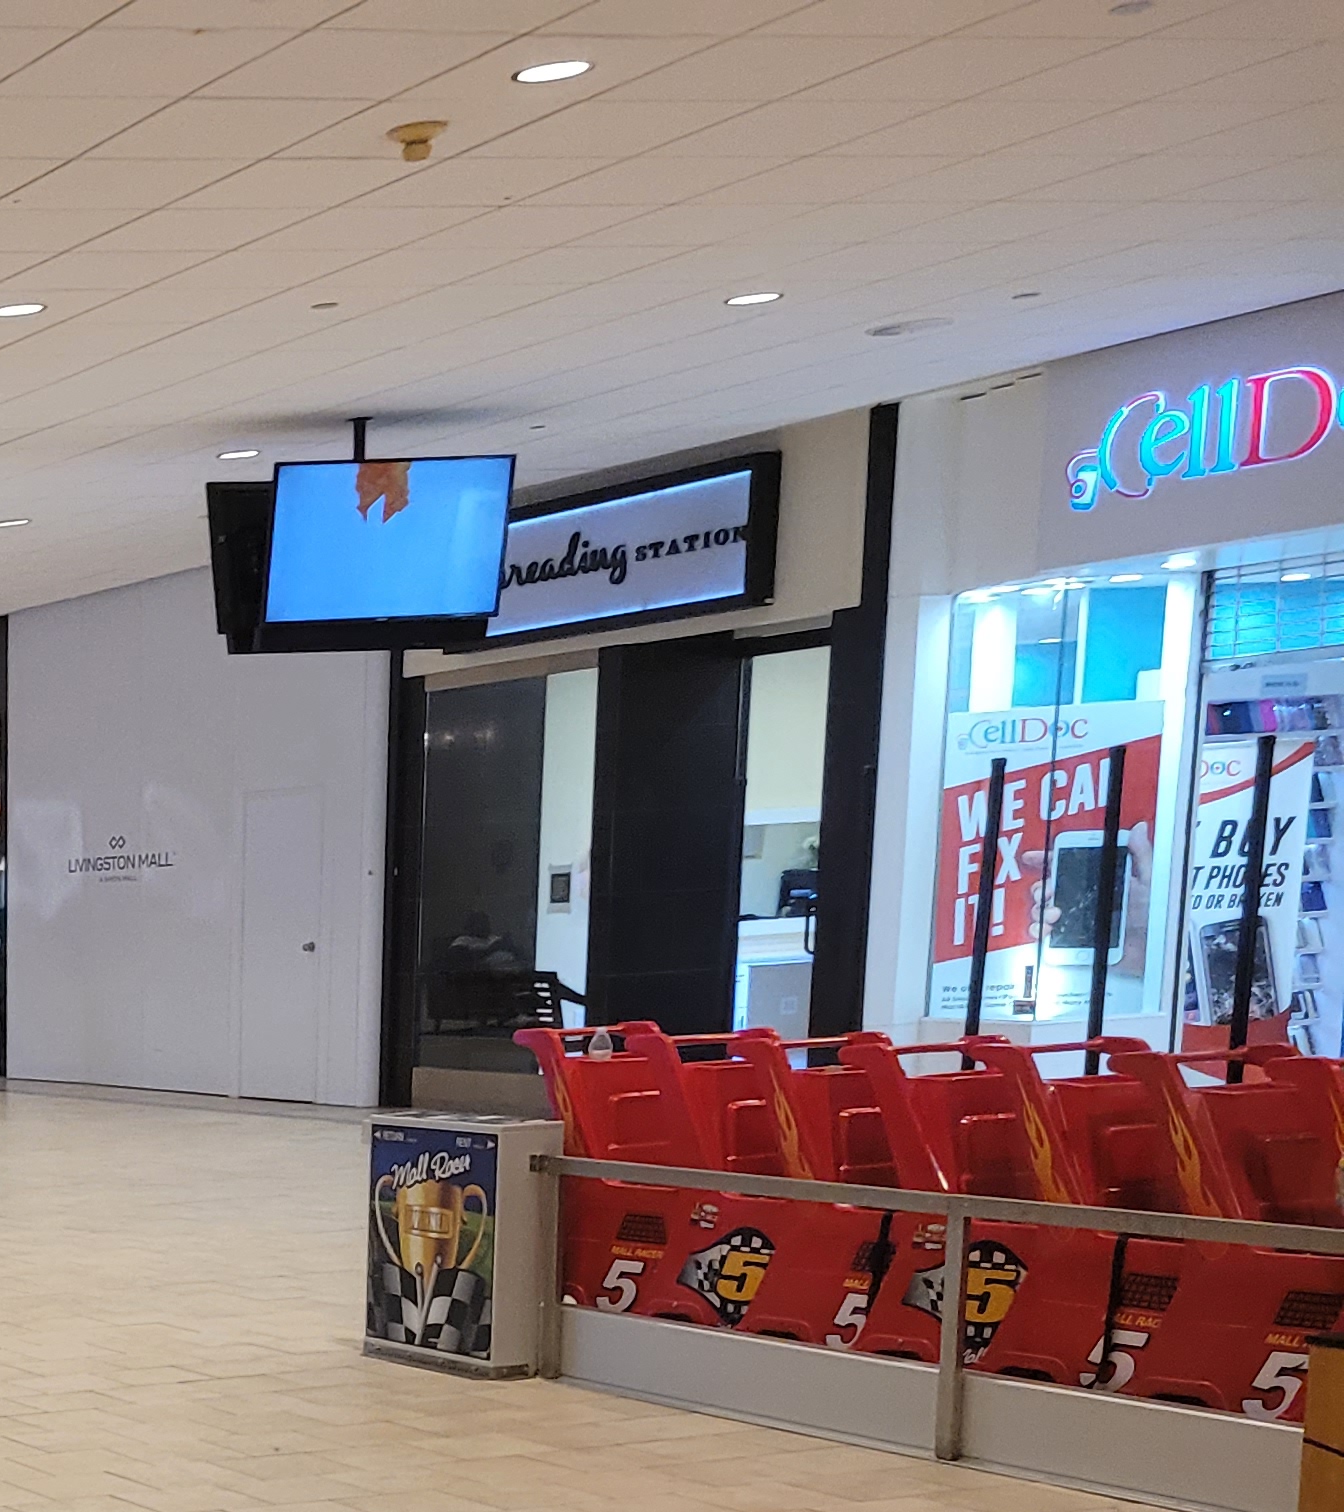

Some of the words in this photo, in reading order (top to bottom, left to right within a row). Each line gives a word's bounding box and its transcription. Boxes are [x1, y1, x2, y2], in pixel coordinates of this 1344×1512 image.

[1098, 365, 1344, 499] CellD
[500, 531, 627, 584] reading
[957, 779, 1027, 842] WE
[68, 855, 136, 873] LIVINGSTON
[138, 852, 174, 867] MALL
[957, 832, 1023, 896] FX
[1204, 862, 1290, 890] PHOES
[1205, 893, 1225, 910] OR
[390, 1152, 431, 1190] Mall
[612, 1245, 636, 1256] MALL
[716, 1251, 771, 1301] 5
[596, 1259, 645, 1312] 5
[965, 1268, 1018, 1323] 5
[825, 1292, 869, 1350] 5
[1264, 1333, 1303, 1348] MALL
[1079, 1329, 1150, 1392] 5
[1242, 1351, 1310, 1420] 5
